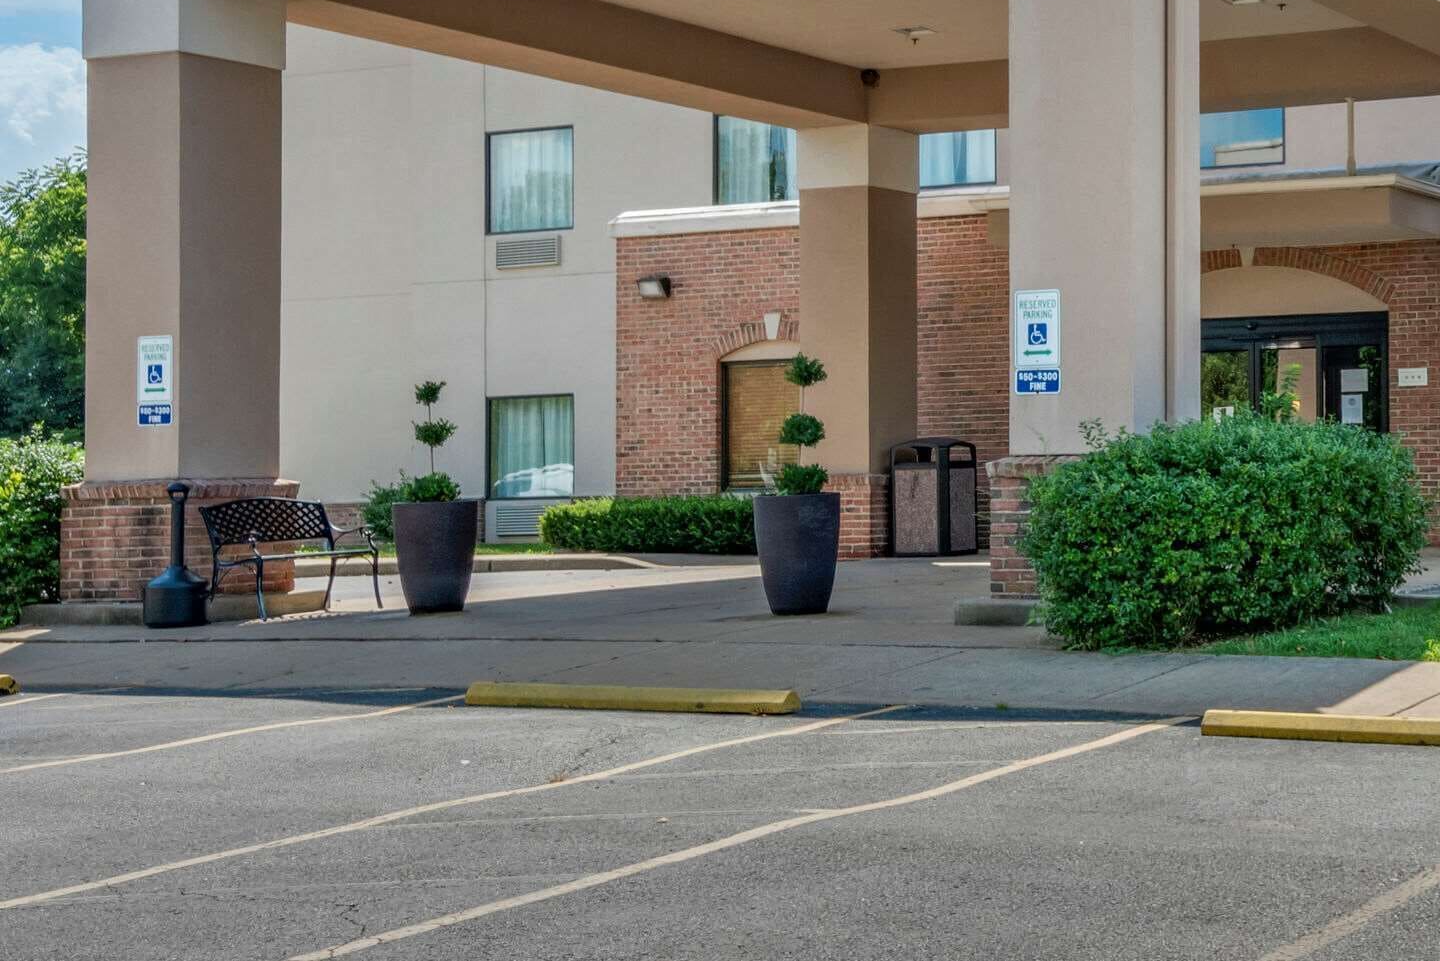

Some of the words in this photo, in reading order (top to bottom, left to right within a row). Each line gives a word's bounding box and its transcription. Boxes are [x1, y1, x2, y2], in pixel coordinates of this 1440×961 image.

[1019, 300, 1056, 309] RESERVED
[1023, 309, 1053, 320] PARKING
[1029, 382, 1047, 391] FINE
